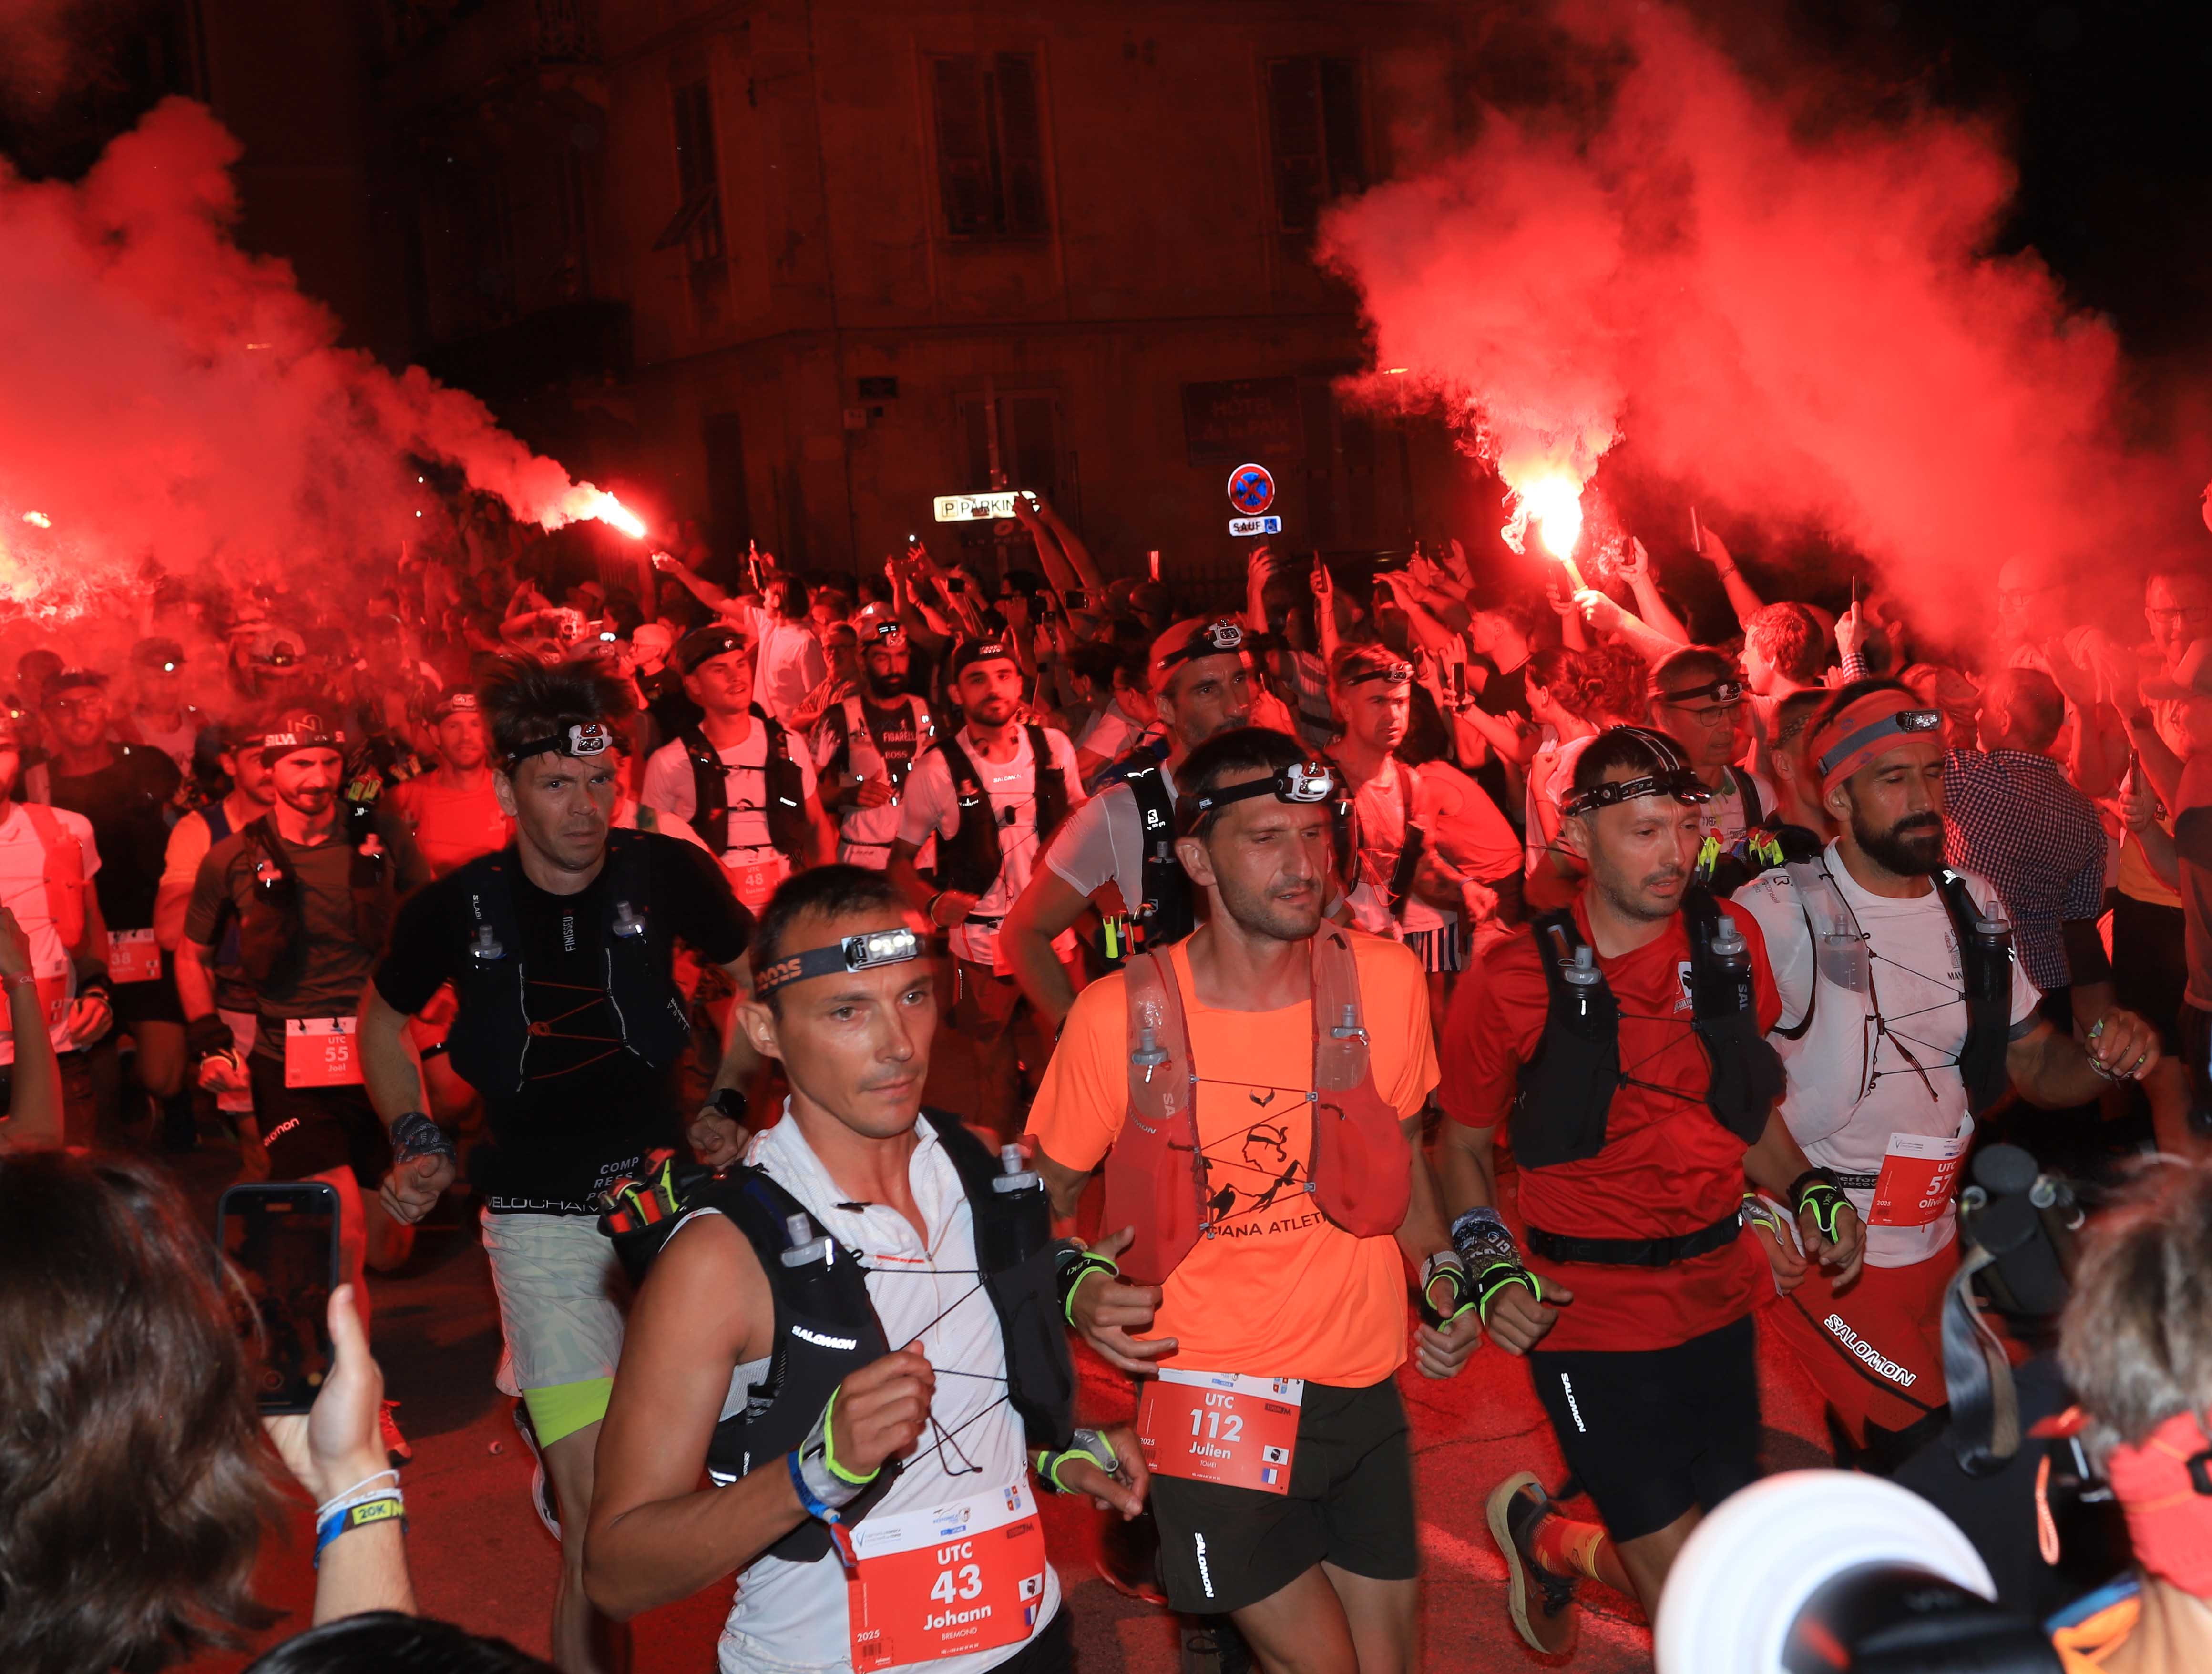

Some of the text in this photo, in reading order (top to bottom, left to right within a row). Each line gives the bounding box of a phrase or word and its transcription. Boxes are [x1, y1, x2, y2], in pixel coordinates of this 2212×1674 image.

[961, 500, 1015, 514] PARKIN
[1233, 521, 1260, 532] SAUF
[264, 733, 297, 747] SILVA
[883, 731, 916, 742] FIGARELL
[885, 750, 908, 759] BOSS
[993, 773, 1022, 783] SALOMON
[745, 872, 764, 886] 48
[1947, 972, 1964, 980] MAN
[1738, 983, 1749, 1011] SAL
[328, 1036, 346, 1044] UTC
[324, 1046, 349, 1062] 55
[600, 1156, 639, 1174] COMP
[1937, 1161, 1956, 1173] UTC
[1925, 1172, 1954, 1196] 57
[791, 1325, 857, 1350] SALOMON
[1824, 1314, 1917, 1387] SALOMON
[1204, 1392, 1235, 1409] UTC
[1561, 1372, 1587, 1432] SALOMON
[1190, 1409, 1244, 1442] 112
[1189, 1441, 1232, 1460] Julien
[358, 1503, 385, 1519] 20K
[937, 1541, 973, 1565] UTC
[1194, 1532, 1215, 1598] SALOMON
[930, 1563, 983, 1604] 43
[923, 1604, 992, 1631] Johann
[857, 1629, 881, 1643] 2025
[941, 1626, 978, 1641] BREMOND
